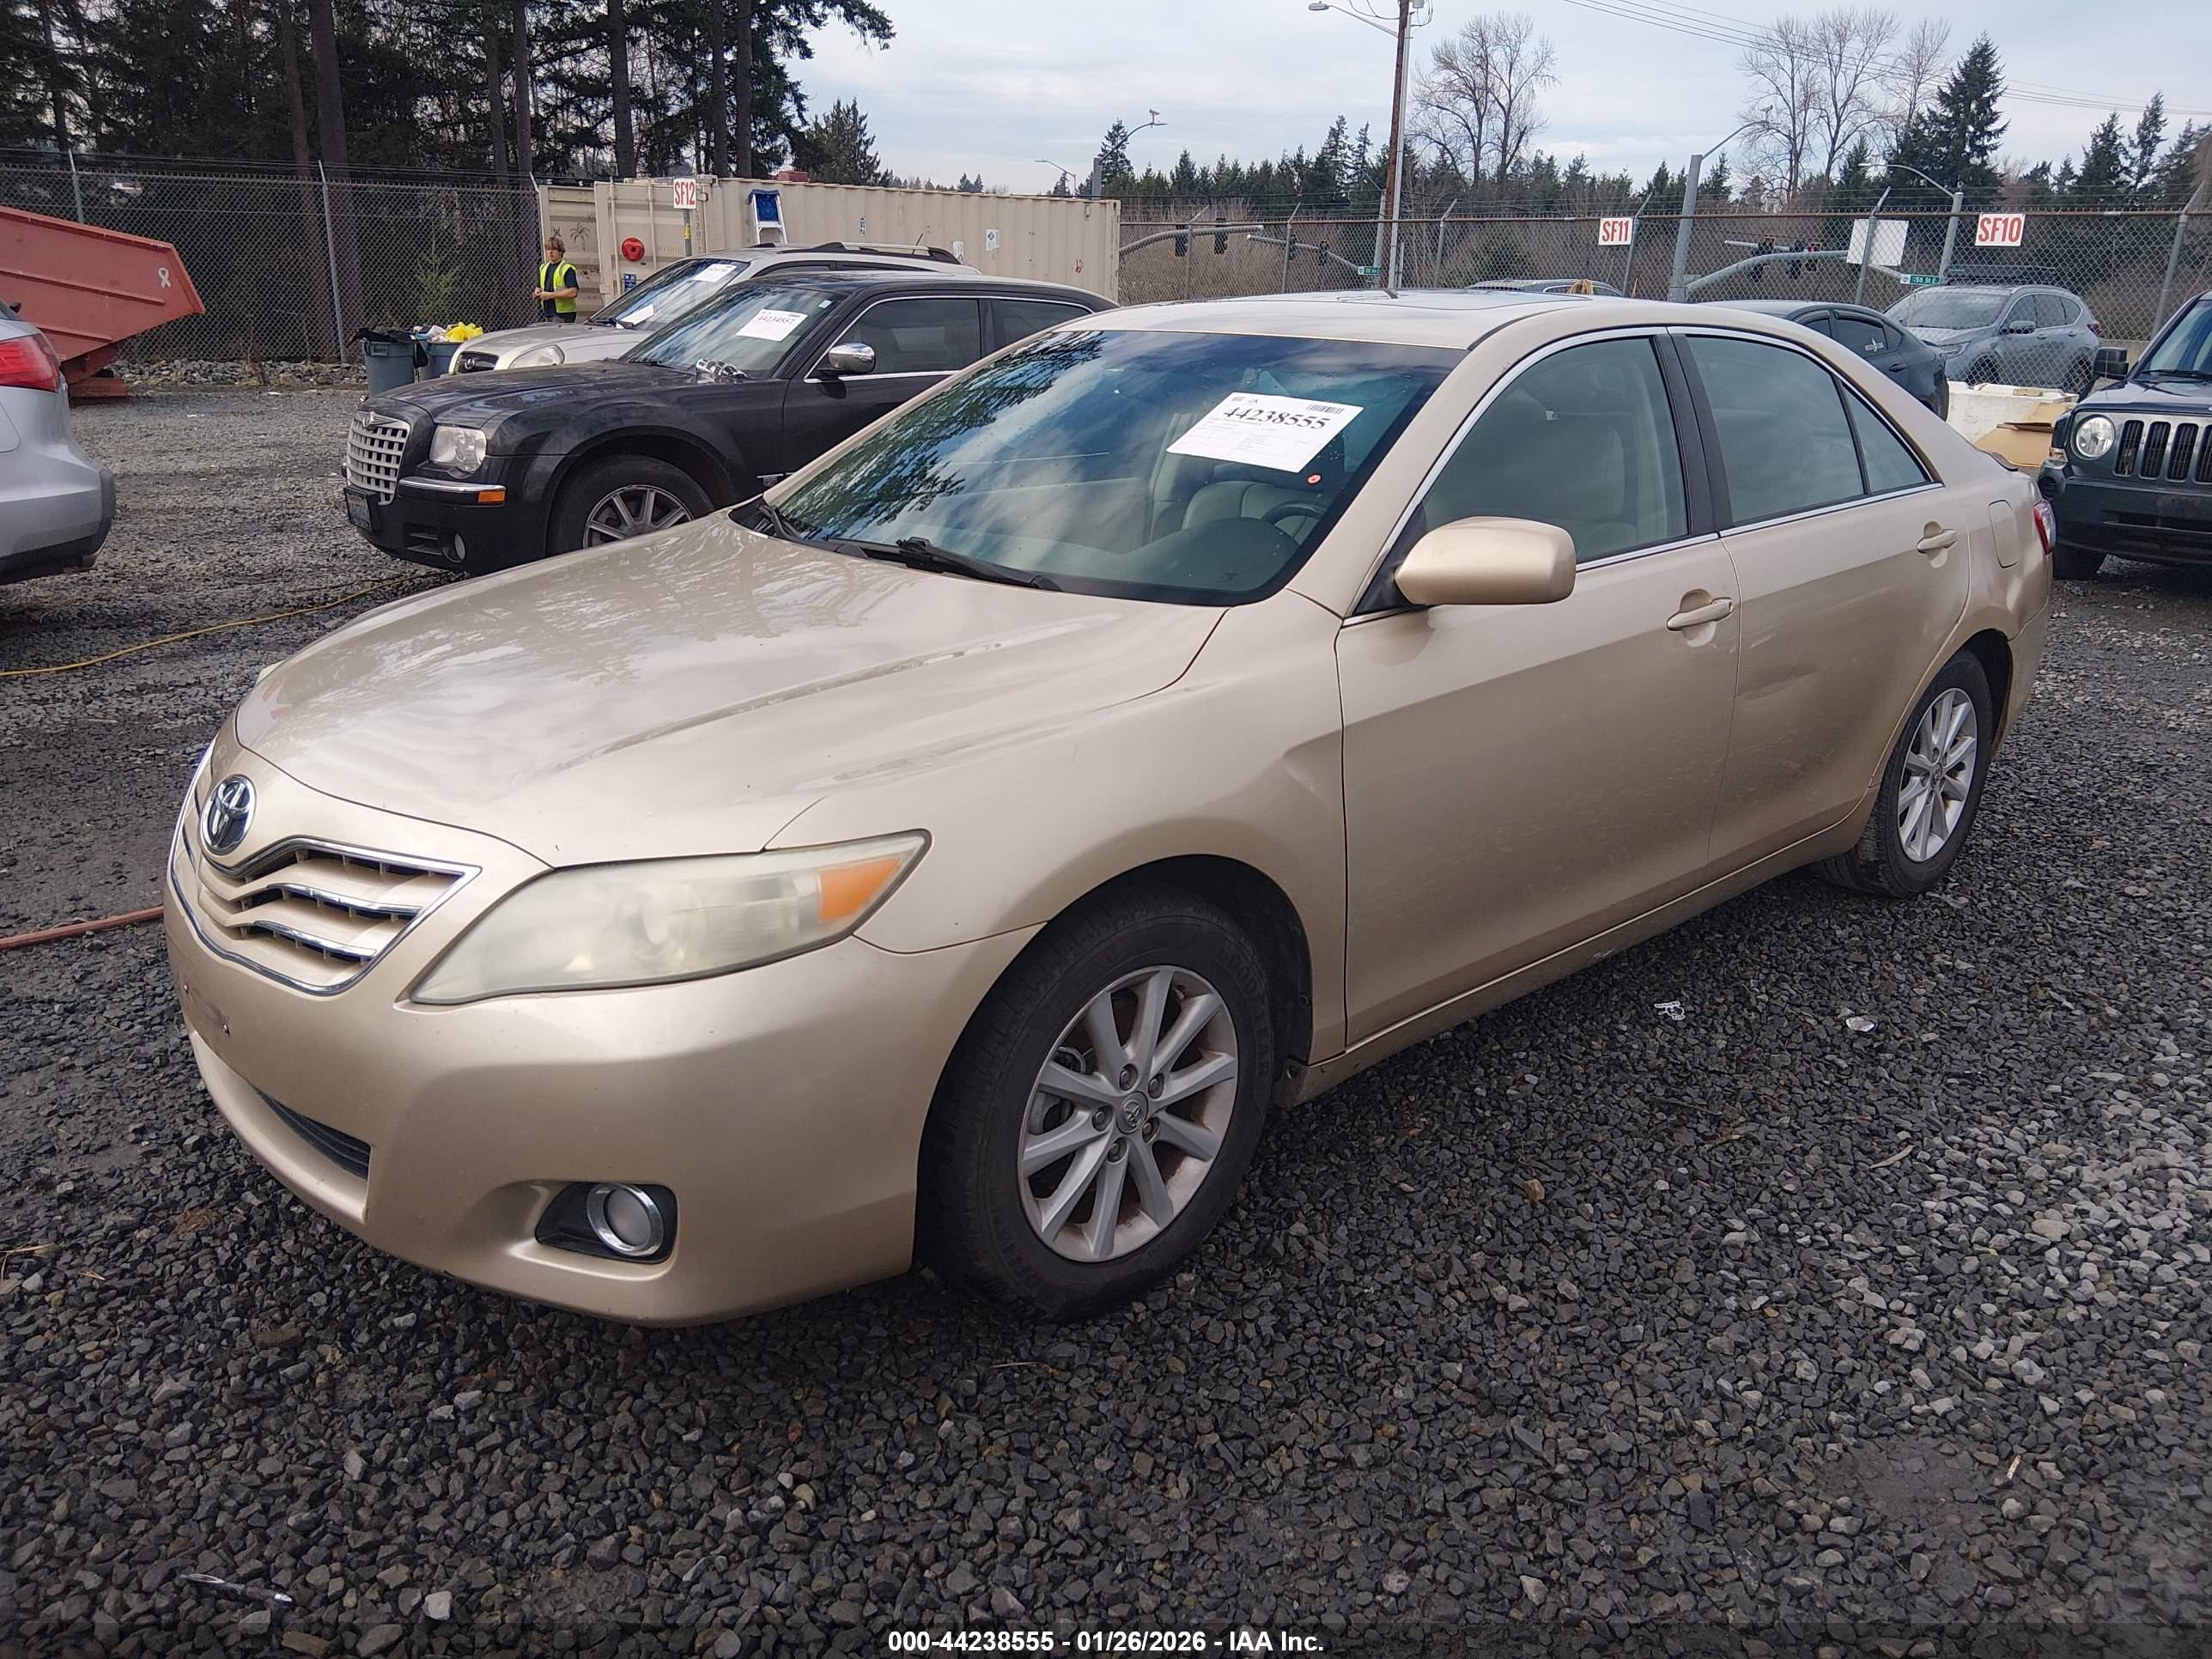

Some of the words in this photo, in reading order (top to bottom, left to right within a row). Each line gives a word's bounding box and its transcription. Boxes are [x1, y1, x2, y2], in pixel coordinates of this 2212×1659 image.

[674, 181, 696, 206] SF12
[1601, 220, 1630, 242] SF11
[1978, 216, 2022, 243] SF10
[1223, 406, 1332, 430] 44238555
